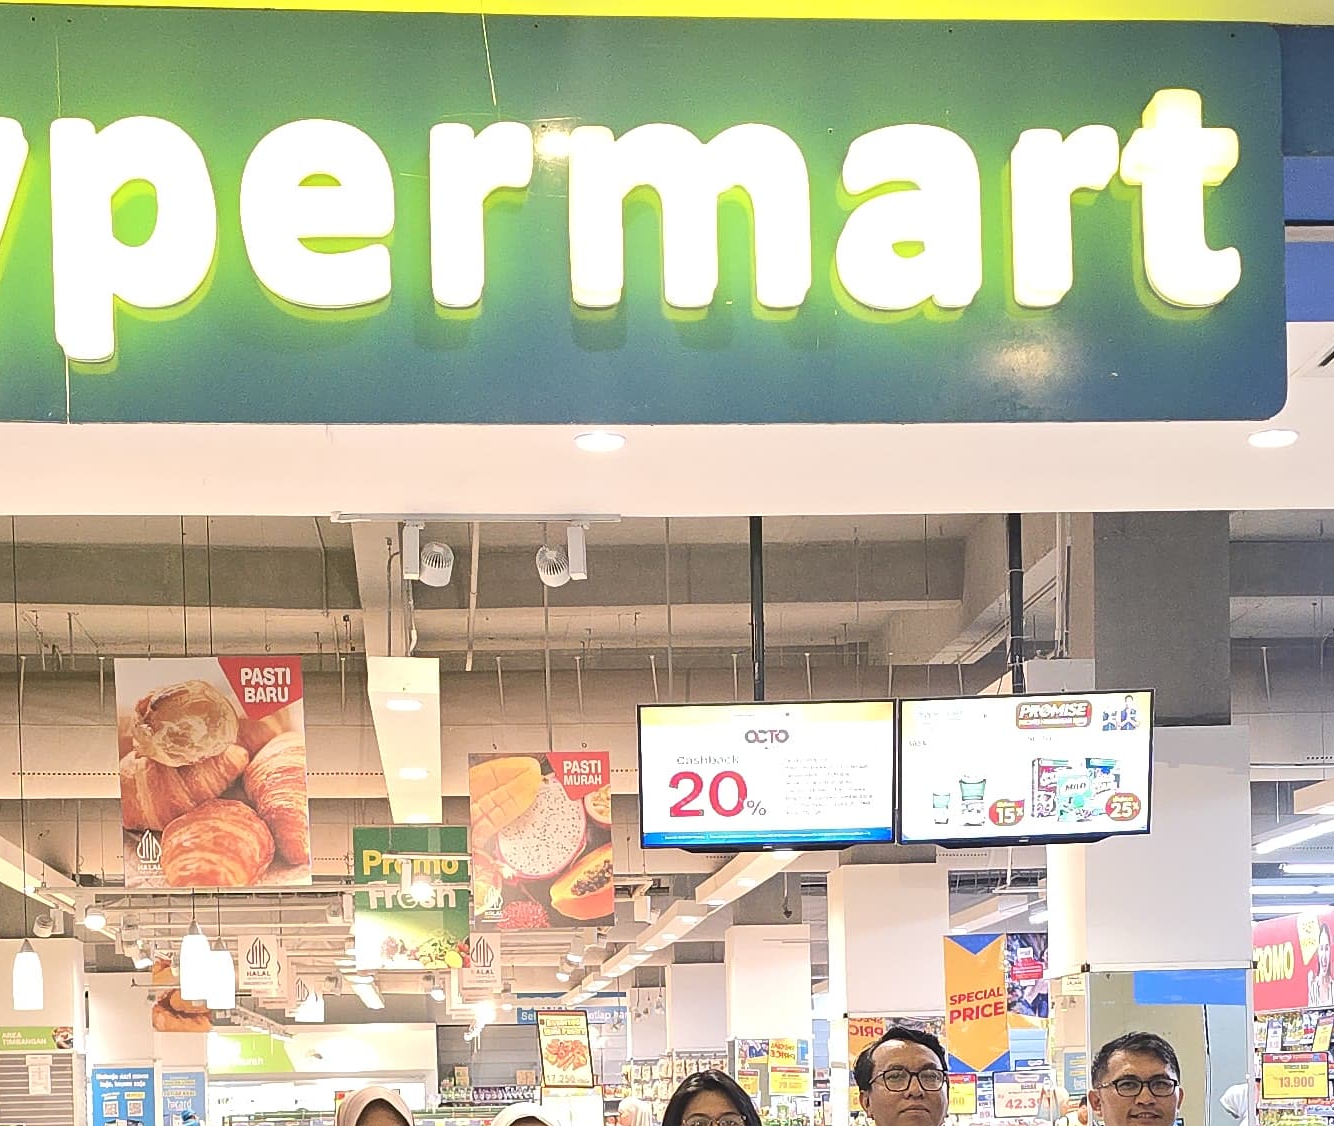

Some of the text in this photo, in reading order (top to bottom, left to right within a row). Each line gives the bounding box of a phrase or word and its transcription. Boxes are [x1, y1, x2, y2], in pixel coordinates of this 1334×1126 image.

[240, 668, 291, 686] PASTI
[244, 686, 289, 704] BARU
[1019, 702, 1088, 719] PROMISE
[744, 729, 789, 743] OCTO
[563, 760, 602, 776] PASTI
[563, 774, 602, 787] MURAH
[950, 986, 1003, 1006] SPECIAL
[949, 1001, 1005, 1025] PRICE
[1279, 1076, 1315, 1088] 13.900
[1005, 1097, 1043, 1110] 42.3
